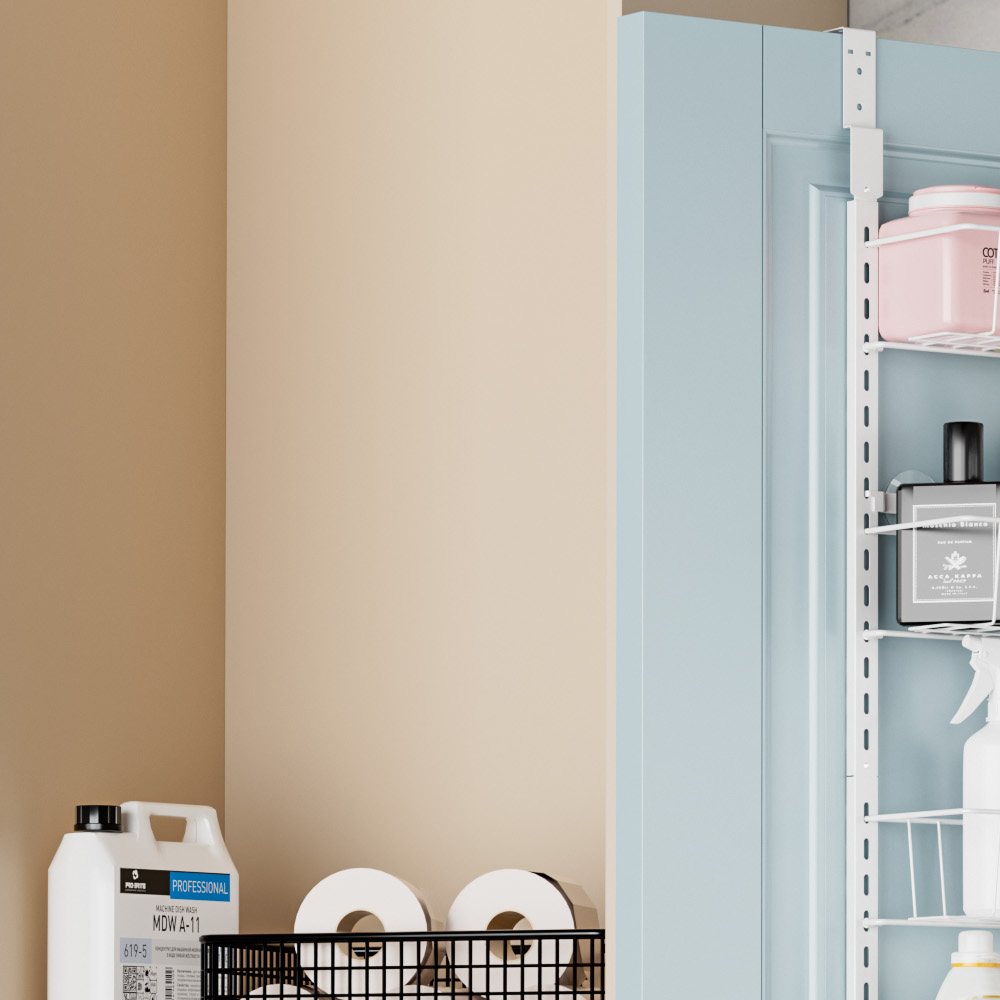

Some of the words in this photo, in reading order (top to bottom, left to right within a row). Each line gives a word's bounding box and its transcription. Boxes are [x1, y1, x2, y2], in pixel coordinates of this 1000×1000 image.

[172, 879, 228, 894] PROFESSIONAL
[156, 905, 174, 913] MACHINE
[175, 906, 185, 914] DISH
[186, 906, 198, 914] WASH
[152, 914, 177, 932] MDW
[179, 916, 200, 933] A-11
[124, 943, 147, 958] 619-5
